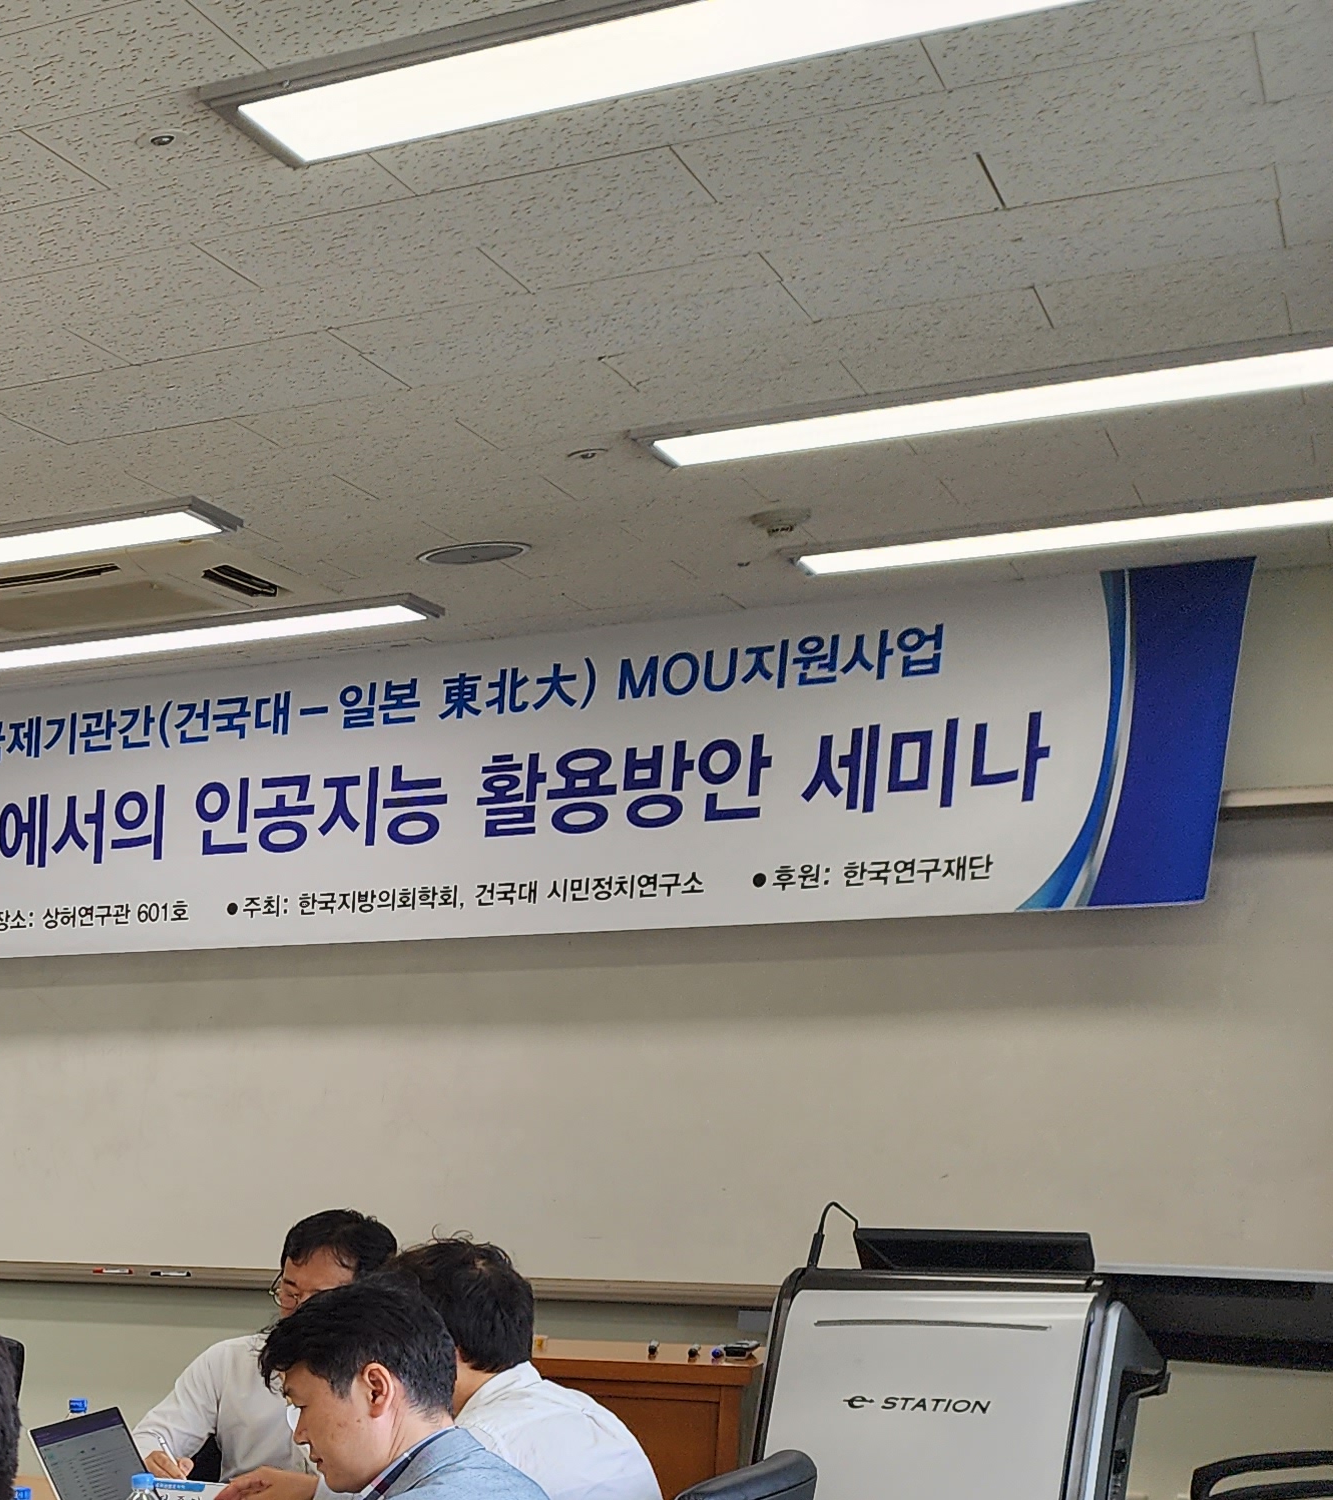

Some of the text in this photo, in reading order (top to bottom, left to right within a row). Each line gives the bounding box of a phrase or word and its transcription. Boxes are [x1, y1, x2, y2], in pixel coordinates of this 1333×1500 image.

[439, 657, 596, 719] 東北大)
[618, 623, 943, 700] MOU지원사업
[196, 765, 447, 855] 인공지능
[477, 734, 772, 837] 활용방안
[801, 711, 1050, 813] 세미나
[43, 904, 130, 929] 상허연구관
[138, 901, 188, 922] 601호
[243, 895, 288, 918] 주최:
[299, 885, 464, 915] 한국지방의회학회,
[475, 881, 537, 906] 건국대
[547, 872, 704, 902] 시민정치연구소
[773, 864, 830, 891] 후원:
[844, 854, 993, 887] 한국연구재단
[881, 1397, 991, 1414] STATION
